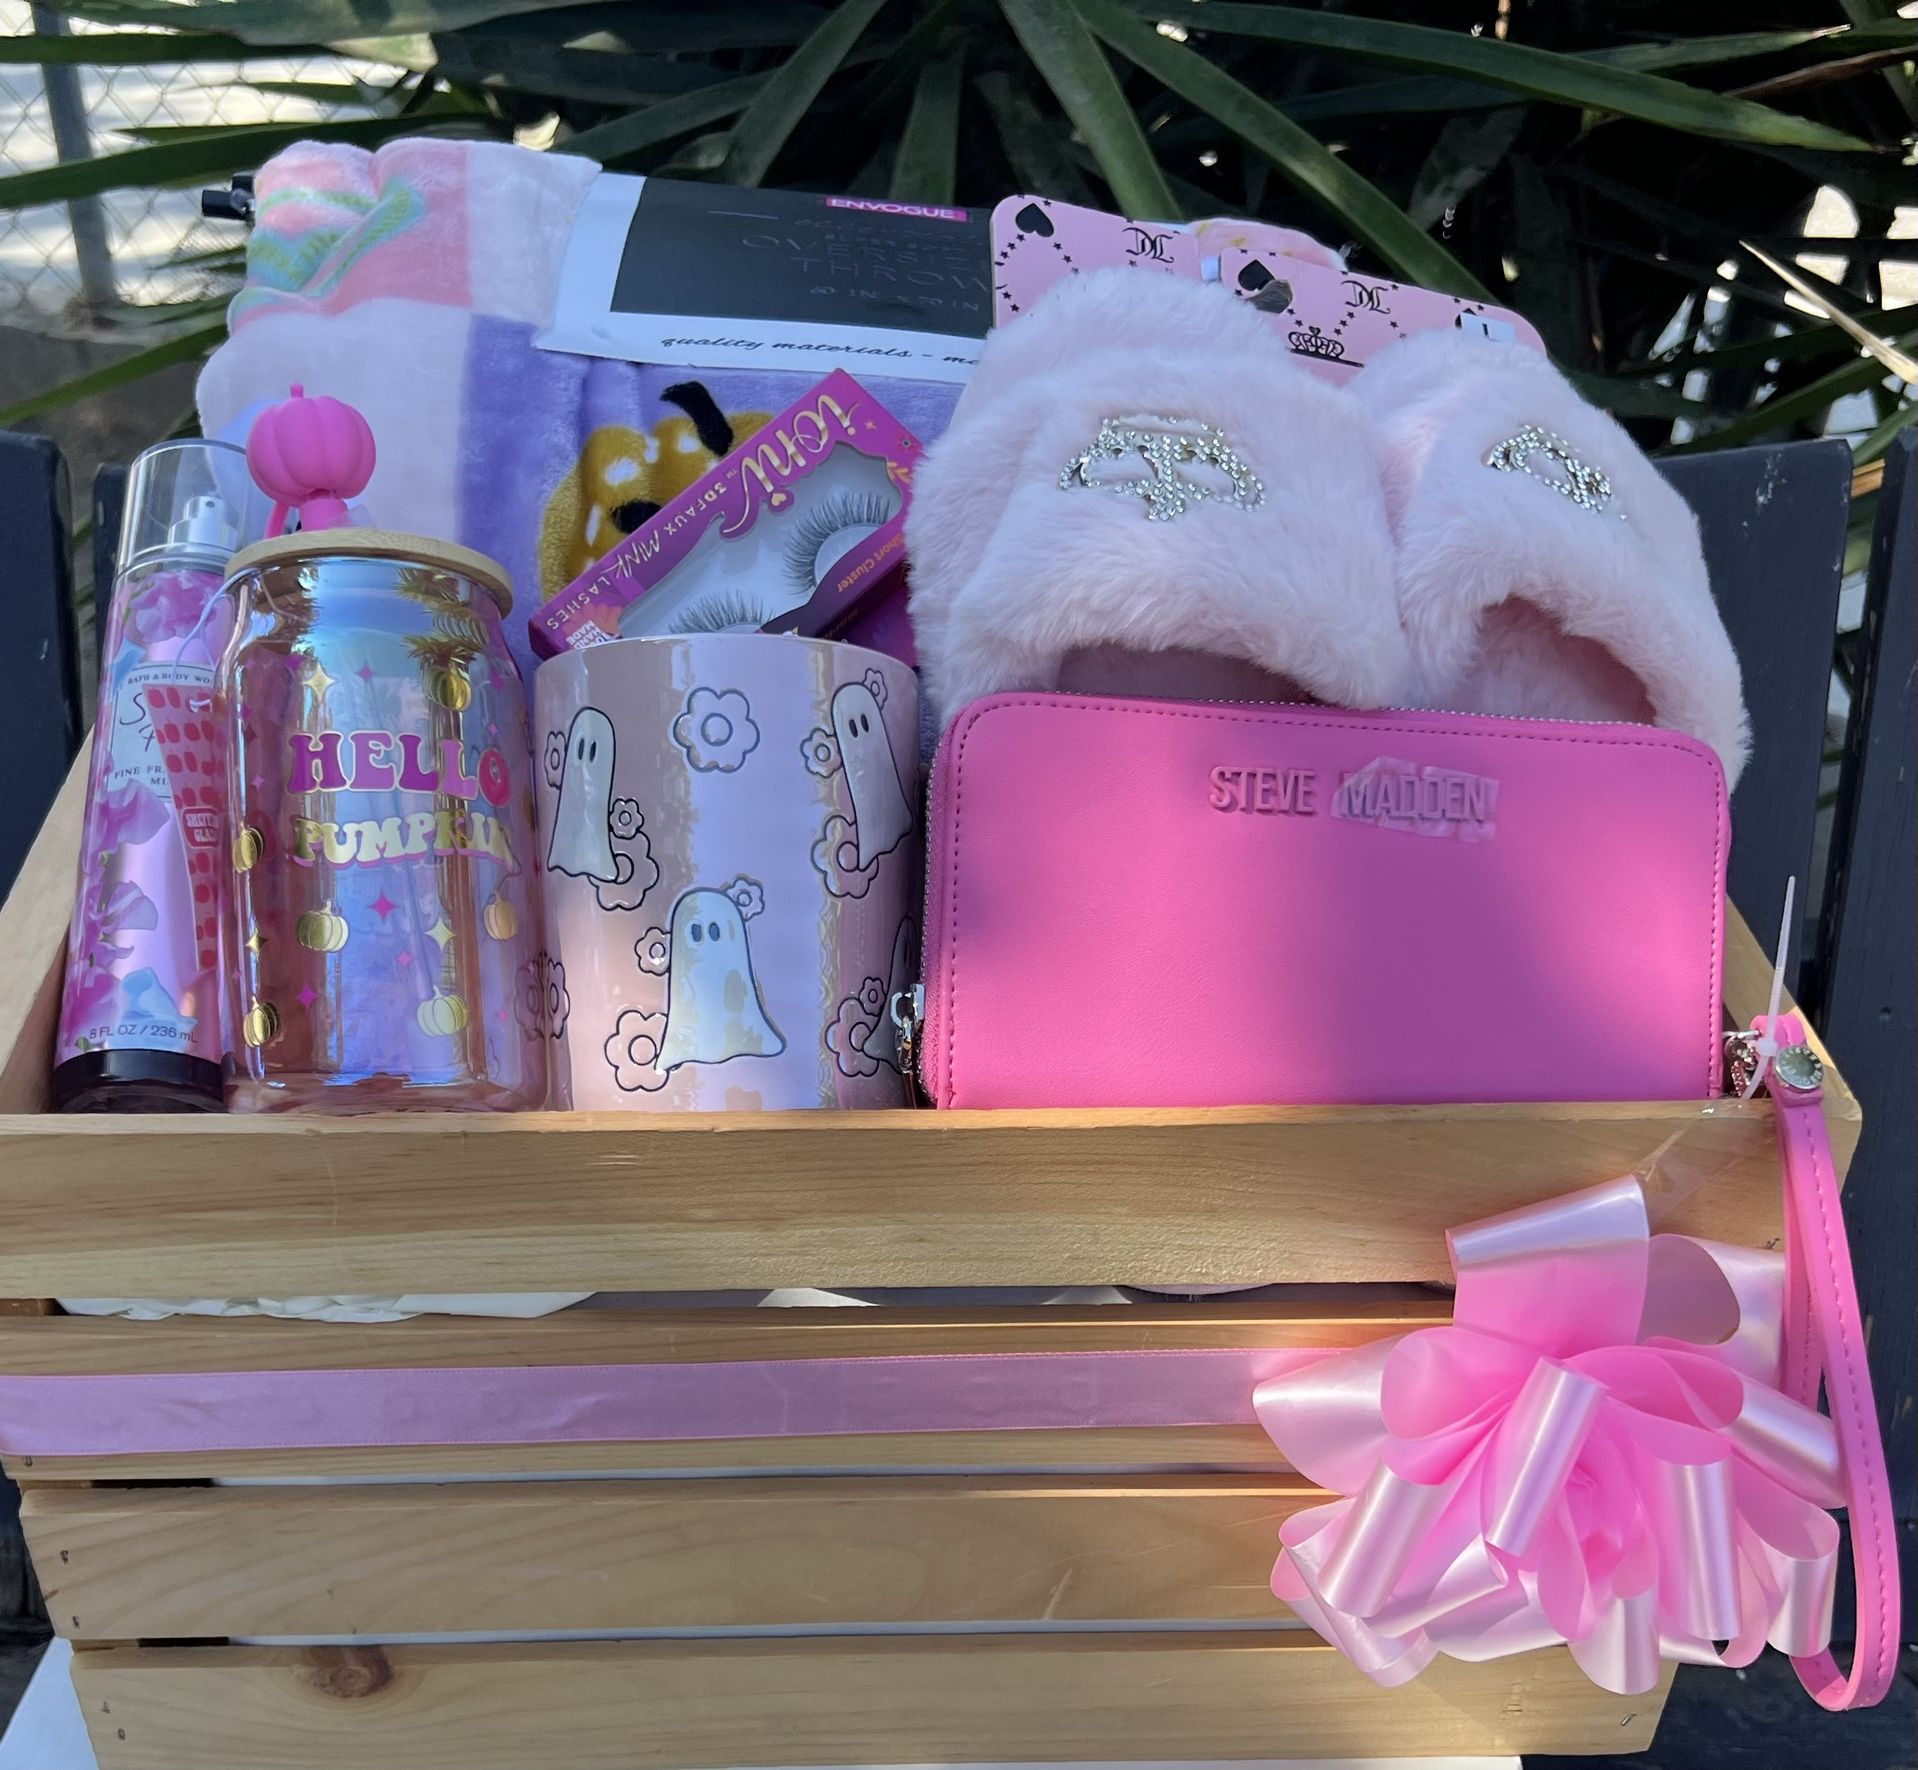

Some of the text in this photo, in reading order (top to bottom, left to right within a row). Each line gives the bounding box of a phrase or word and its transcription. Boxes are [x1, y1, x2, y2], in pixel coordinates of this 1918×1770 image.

[831, 198, 955, 219] ENVOGUE
[661, 337, 764, 350] quality
[772, 341, 912, 358] materials
[600, 530, 661, 579] MINK
[837, 558, 875, 593] Cluster
[546, 576, 611, 630] LASHES
[566, 619, 595, 645] MADE
[127, 673, 150, 685] BATH
[114, 767, 140, 779] FINE
[289, 730, 511, 808] HELLO
[1209, 766, 1488, 823] STEVE MADDEN
[291, 809, 517, 869] PUMPKIN
[99, 1026, 113, 1037] FL
[118, 1024, 137, 1035] OZ
[151, 1025, 177, 1038] 236
